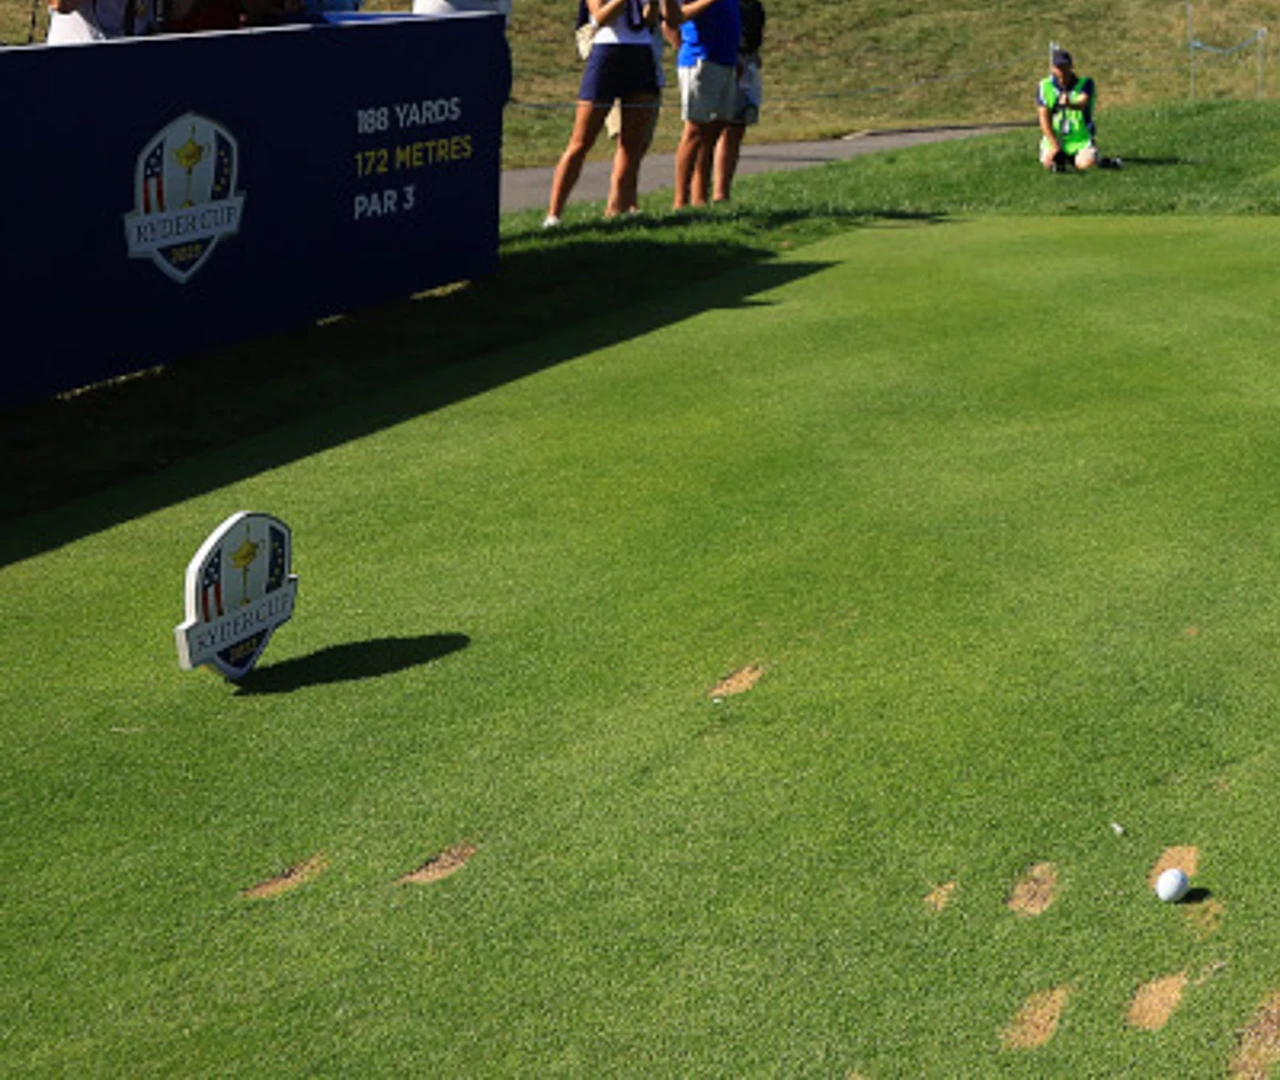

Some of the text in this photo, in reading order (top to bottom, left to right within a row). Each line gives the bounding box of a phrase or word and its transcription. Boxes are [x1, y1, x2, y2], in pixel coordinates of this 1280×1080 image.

[358, 97, 461, 133] 188 YARDS
[355, 135, 472, 177] 172 METRES
[354, 185, 415, 220] PAR 3
[137, 206, 237, 244] RYDER CUP
